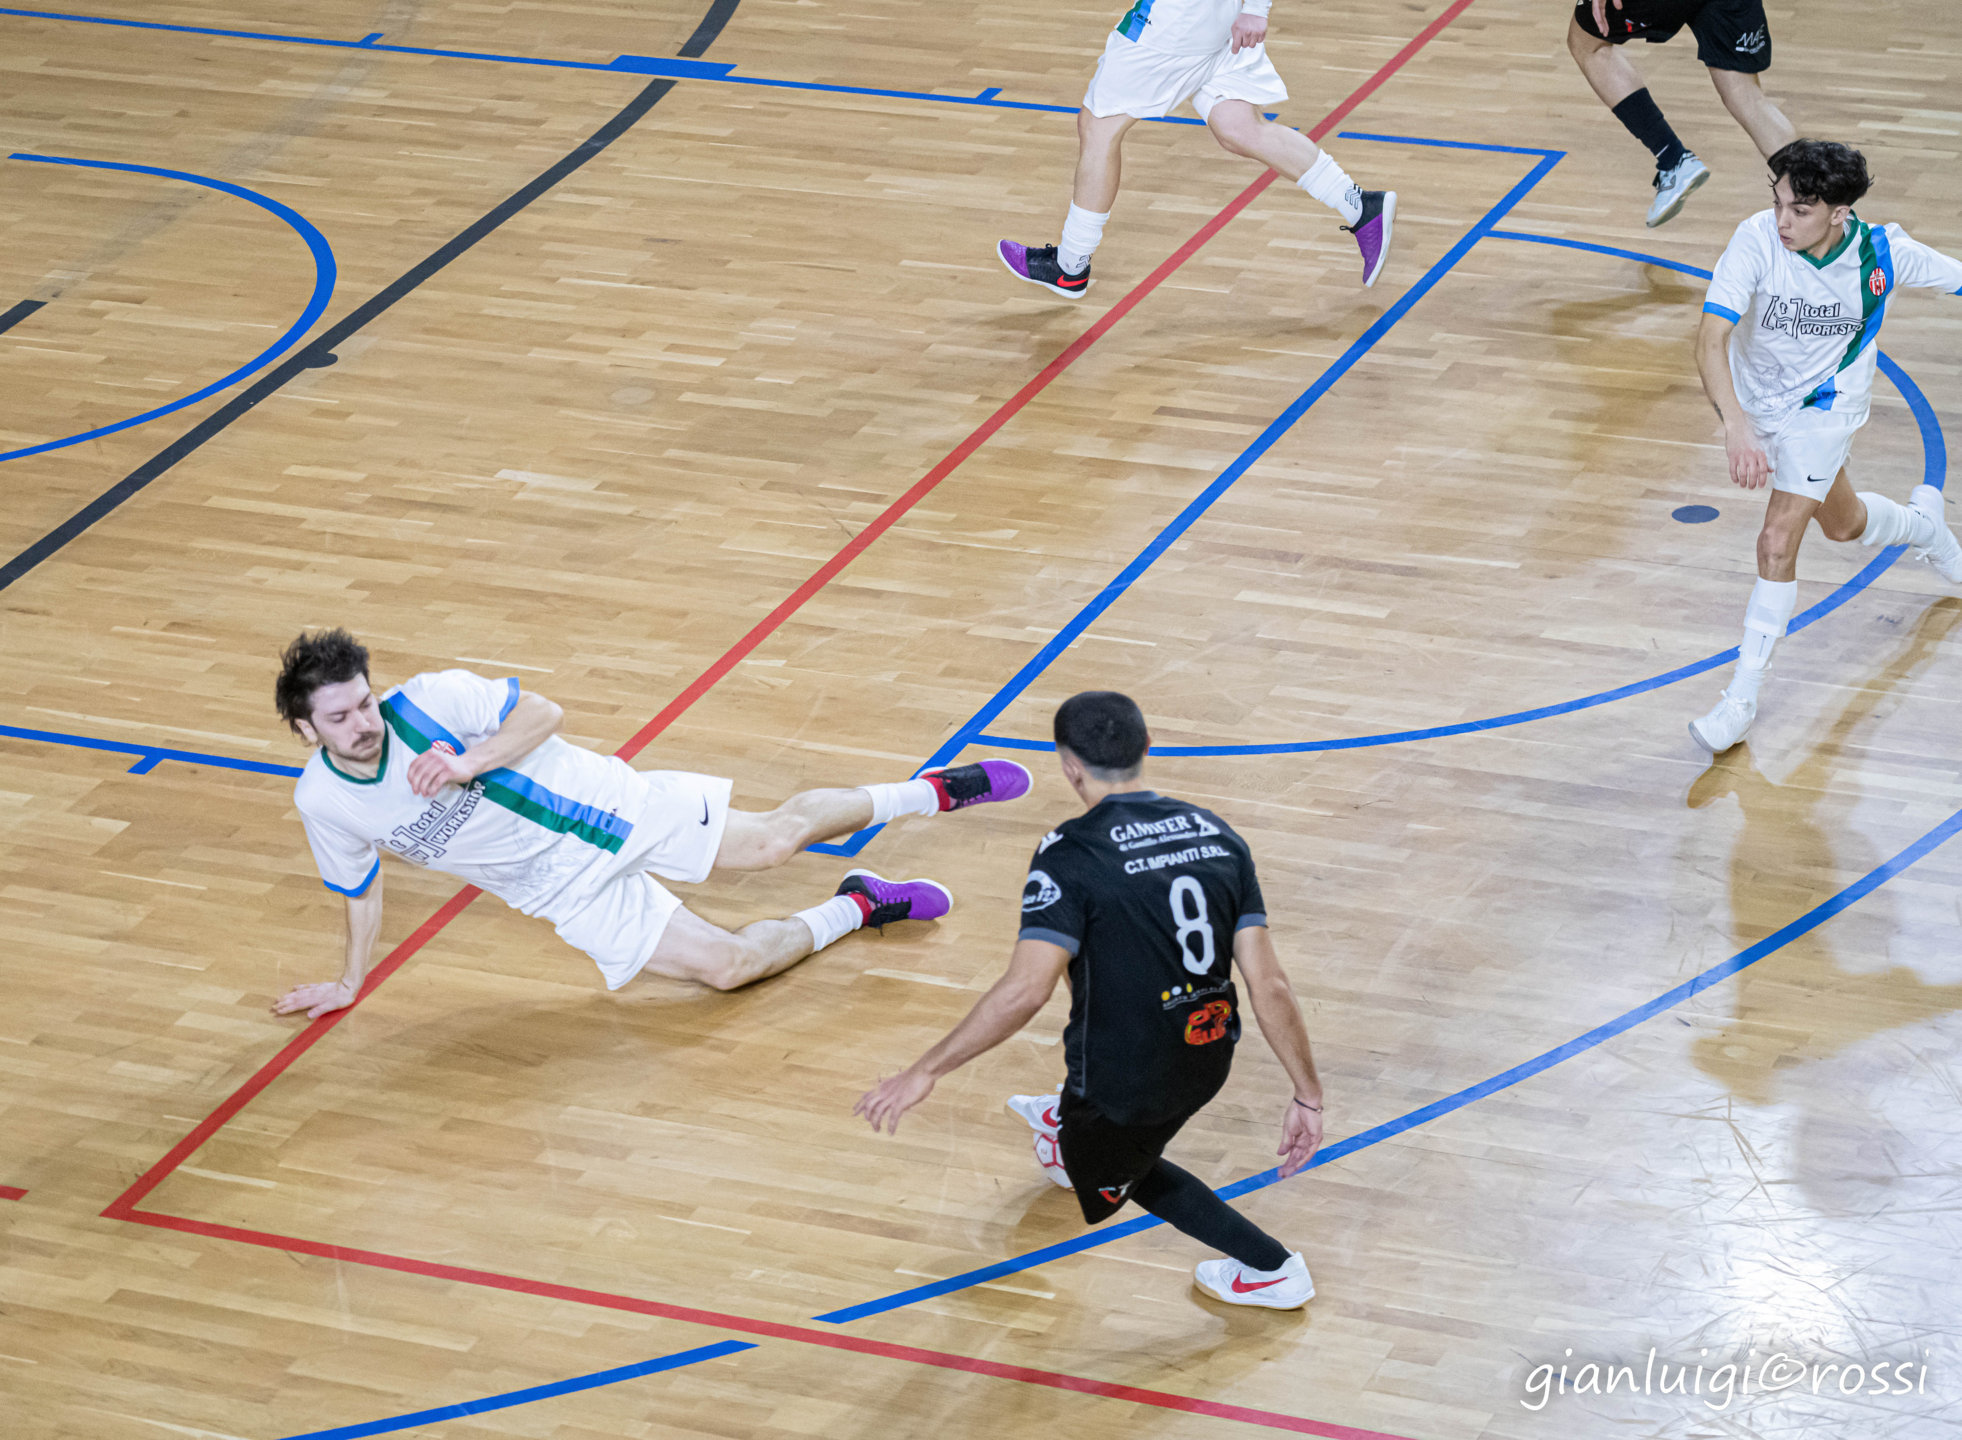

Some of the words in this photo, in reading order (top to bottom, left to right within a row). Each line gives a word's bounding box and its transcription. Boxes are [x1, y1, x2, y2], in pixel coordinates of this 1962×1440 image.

[1803, 303, 1840, 318] total
[409, 800, 447, 834] total
[430, 781, 486, 845] WORKSHOP
[1147, 847, 1200, 870] IMPIANTI
[1169, 875, 1215, 975] 8
